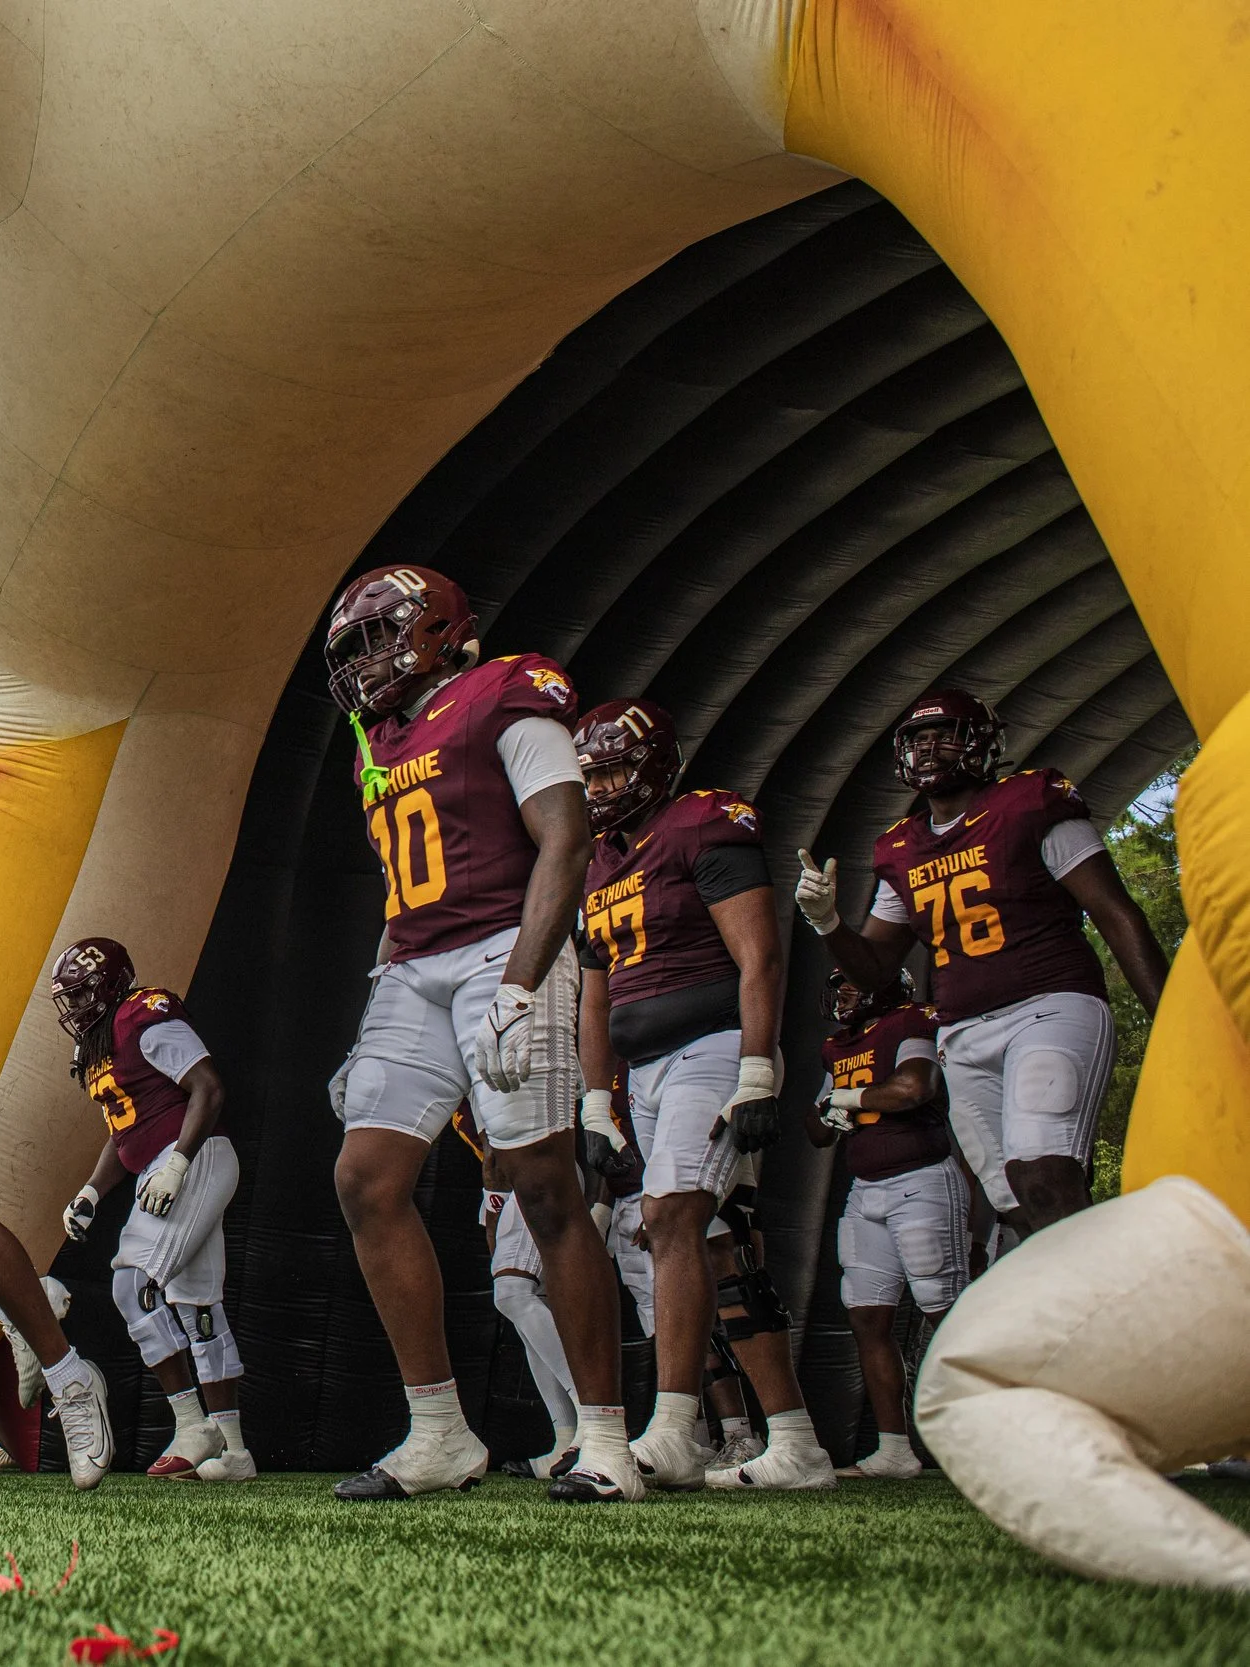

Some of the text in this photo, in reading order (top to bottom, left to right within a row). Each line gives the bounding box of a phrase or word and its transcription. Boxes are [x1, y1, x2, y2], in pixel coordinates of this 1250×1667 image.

[384, 569, 426, 596] 10
[614, 705, 655, 740] 77
[370, 787, 447, 920] 10
[907, 844, 989, 889] BETHUNE
[586, 869, 646, 915] BETHUNE
[587, 893, 647, 978] 77
[913, 869, 1006, 968] 76
[76, 946, 106, 972] 53
